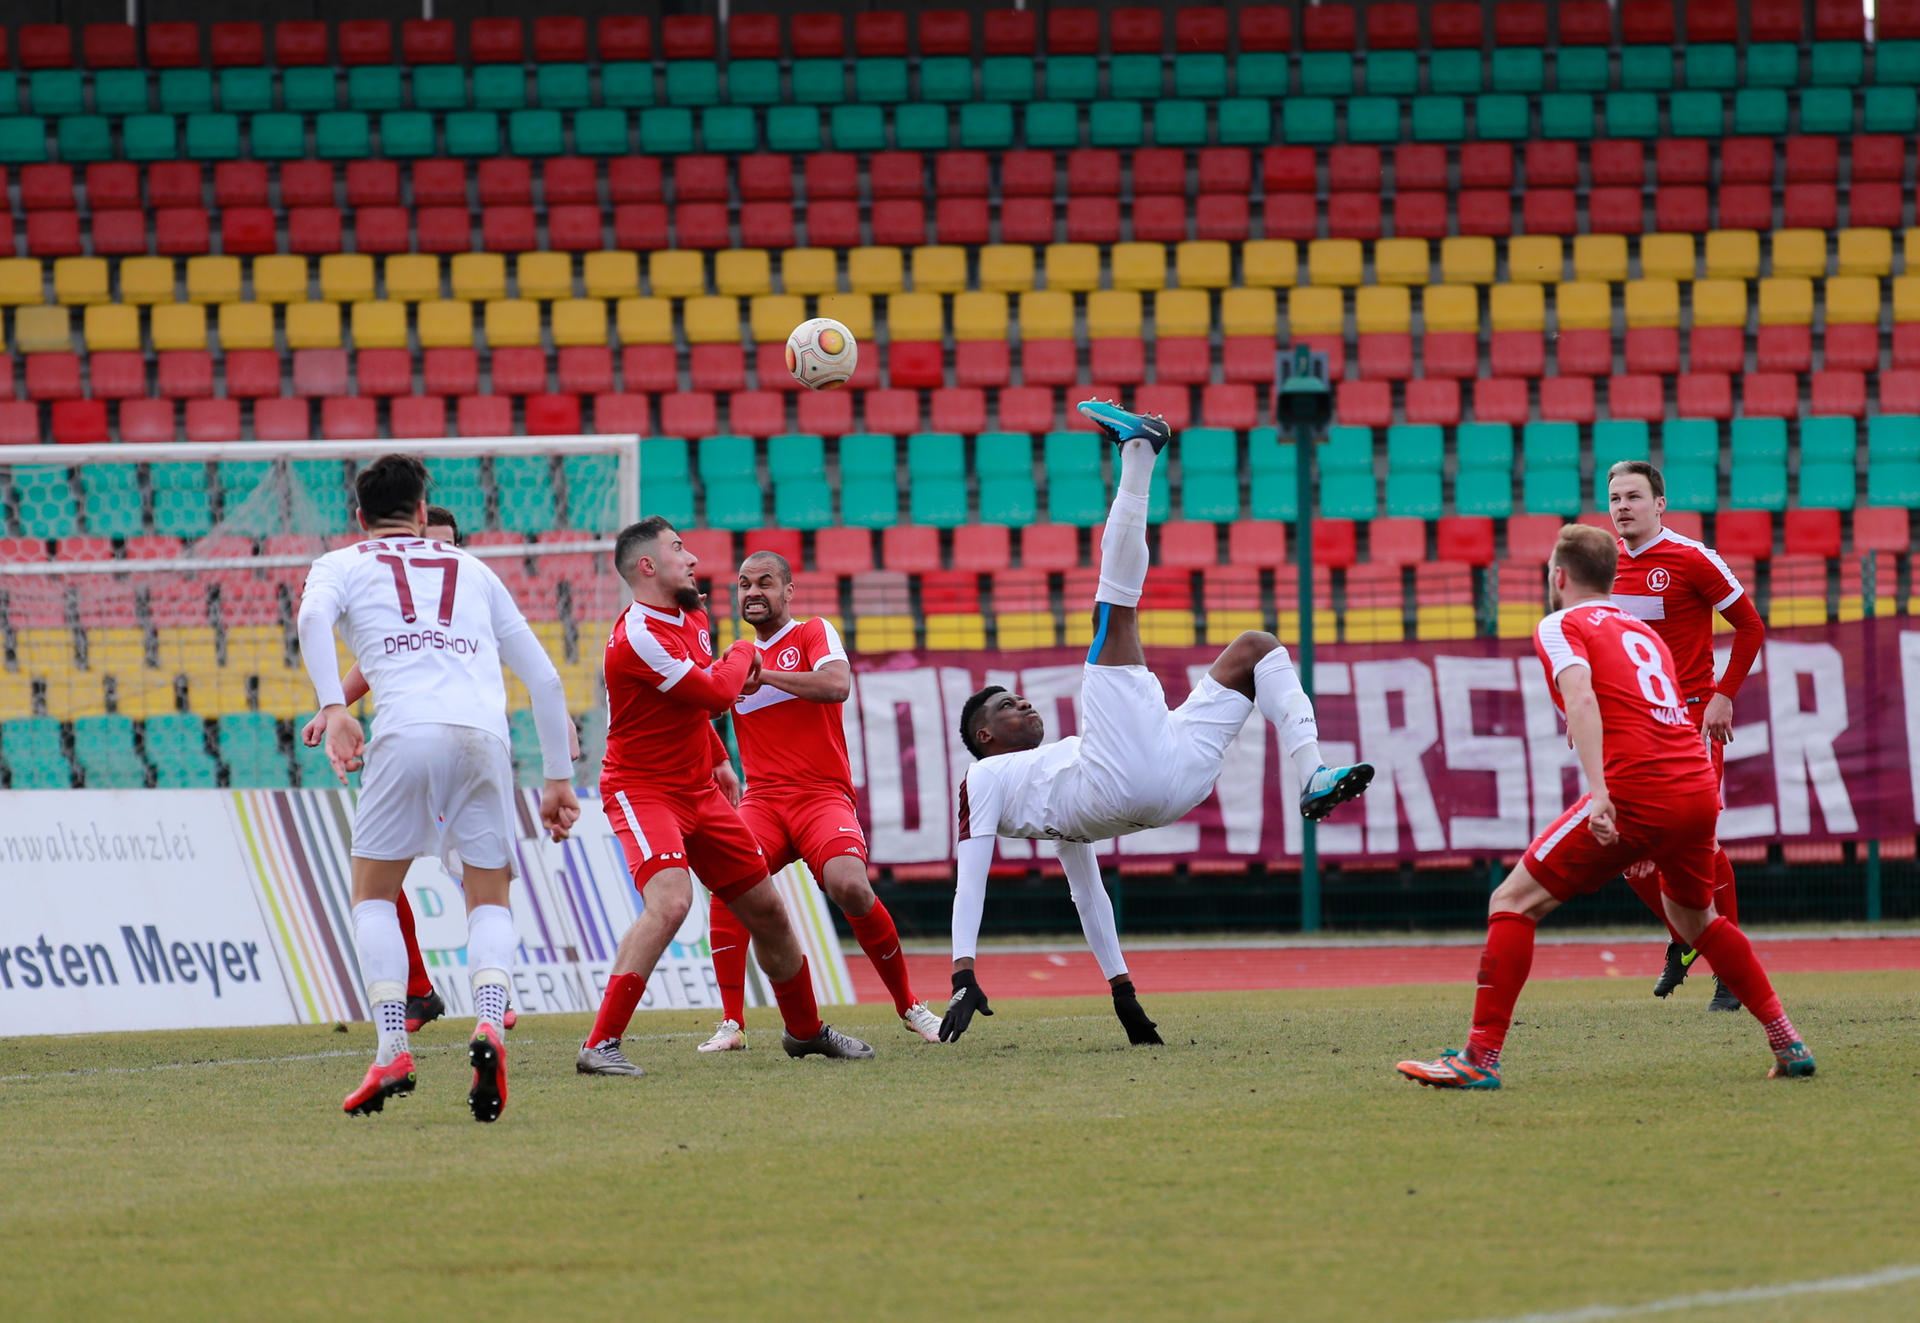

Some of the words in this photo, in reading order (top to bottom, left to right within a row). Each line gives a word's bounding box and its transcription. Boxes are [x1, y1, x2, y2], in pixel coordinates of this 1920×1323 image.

[376, 553, 459, 627] 17
[384, 630, 479, 655] DADASHOV
[1621, 630, 1679, 708] 8
[0, 820, 196, 863] nwaltskanzlei
[119, 925, 262, 998] Meyer
